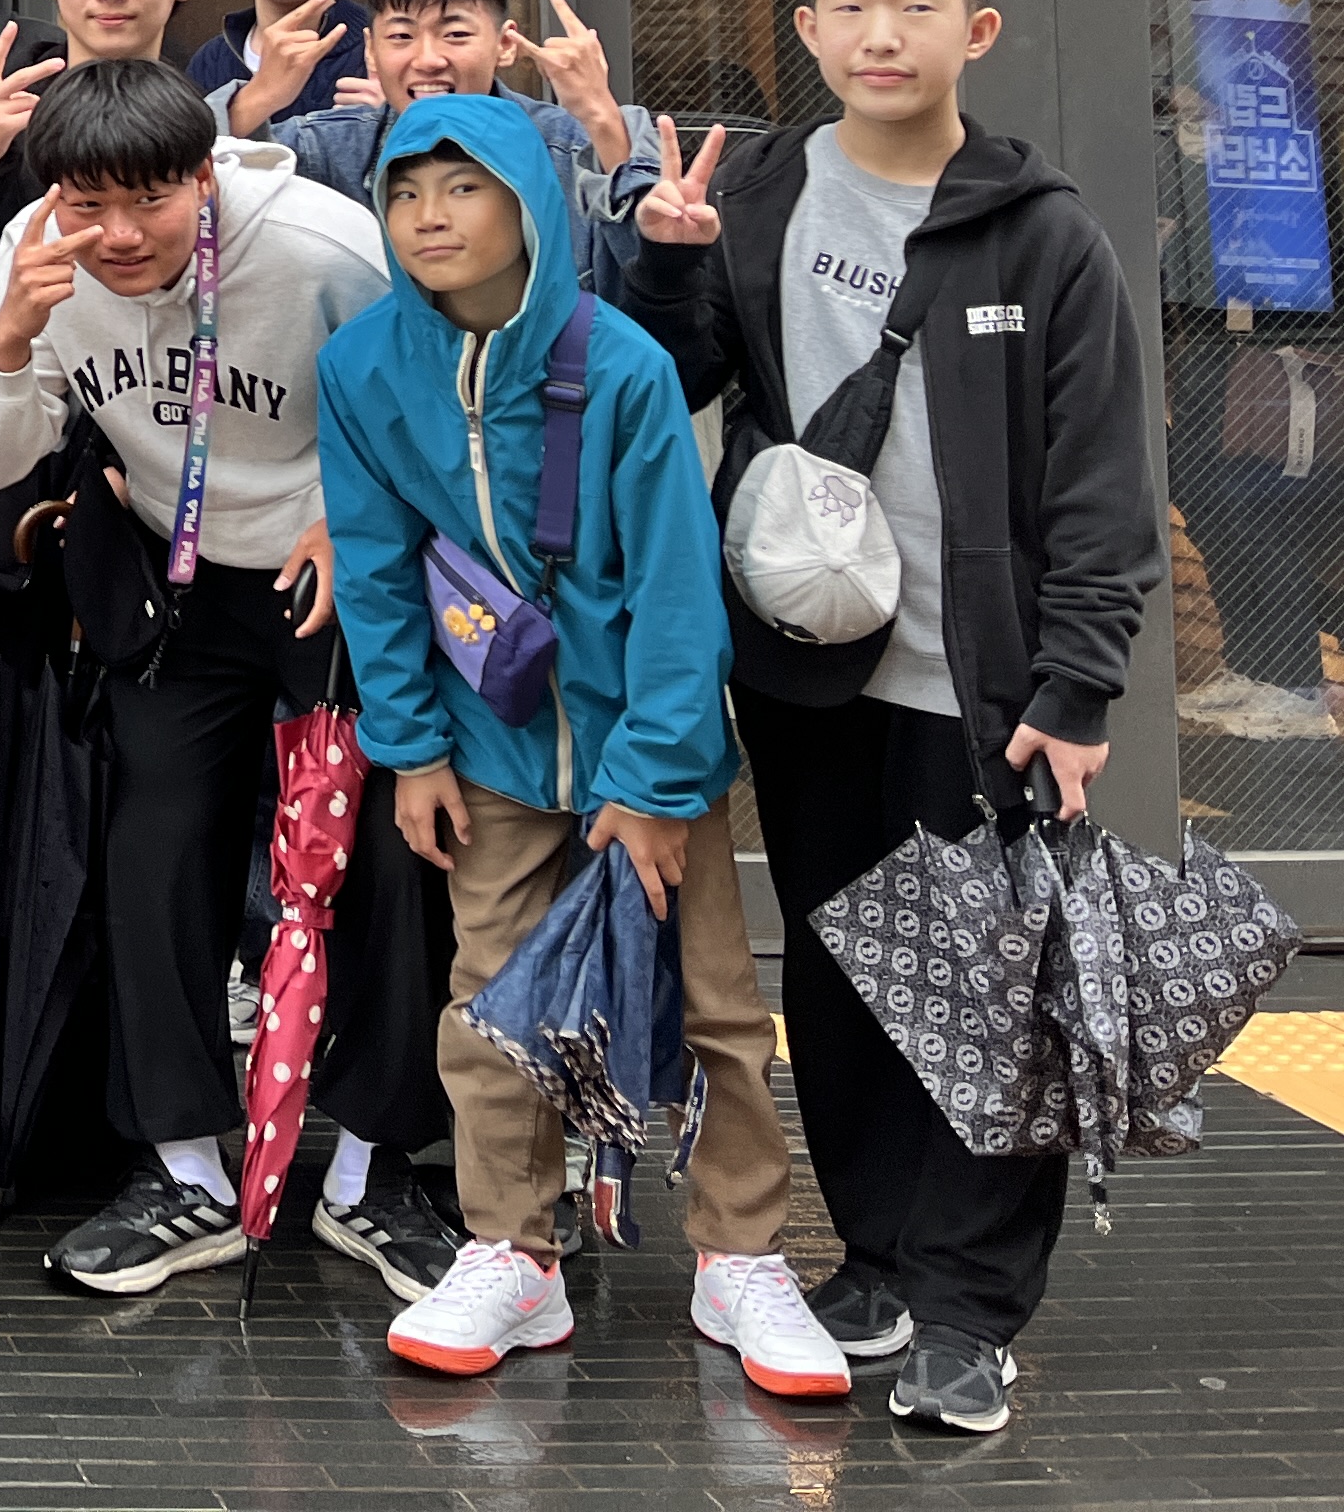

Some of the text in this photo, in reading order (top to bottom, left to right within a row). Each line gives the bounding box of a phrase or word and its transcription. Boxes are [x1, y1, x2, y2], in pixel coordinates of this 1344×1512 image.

[198, 205, 214, 239] FILA
[200, 247, 214, 282] FILA
[201, 291, 214, 325] FILA
[198, 368, 212, 403] FILA
[192, 411, 208, 447] FILA
[187, 455, 203, 490] FILA
[183, 498, 199, 533] FILA
[177, 540, 194, 575] FILA
